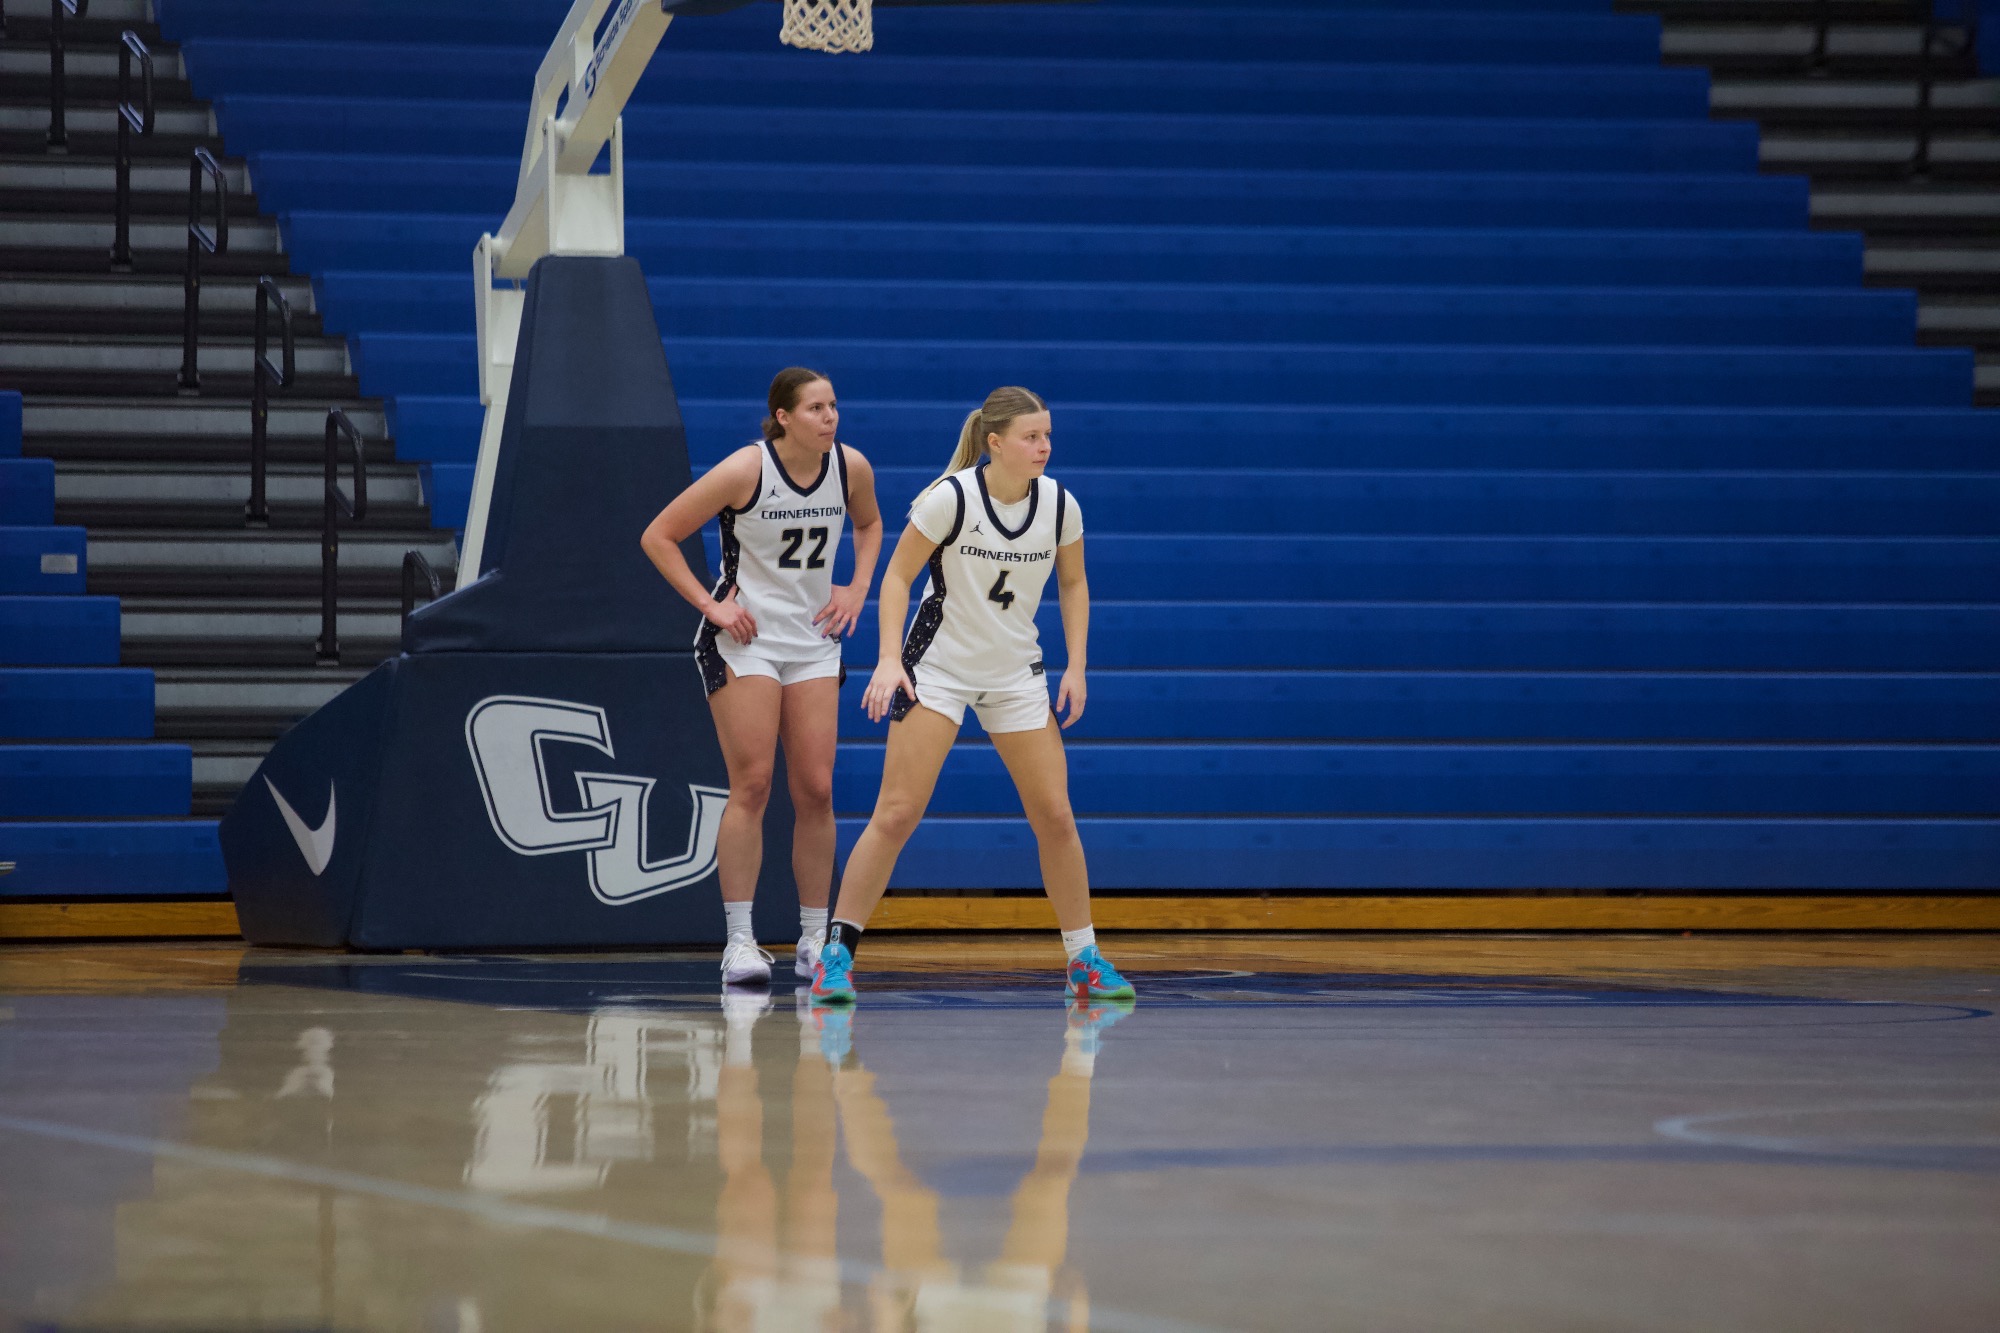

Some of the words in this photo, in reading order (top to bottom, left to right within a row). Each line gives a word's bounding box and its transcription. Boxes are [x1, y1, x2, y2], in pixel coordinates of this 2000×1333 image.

[778, 526, 828, 569] 22
[959, 545, 1052, 563] CORNERSTONE
[988, 569, 1016, 611] 4
